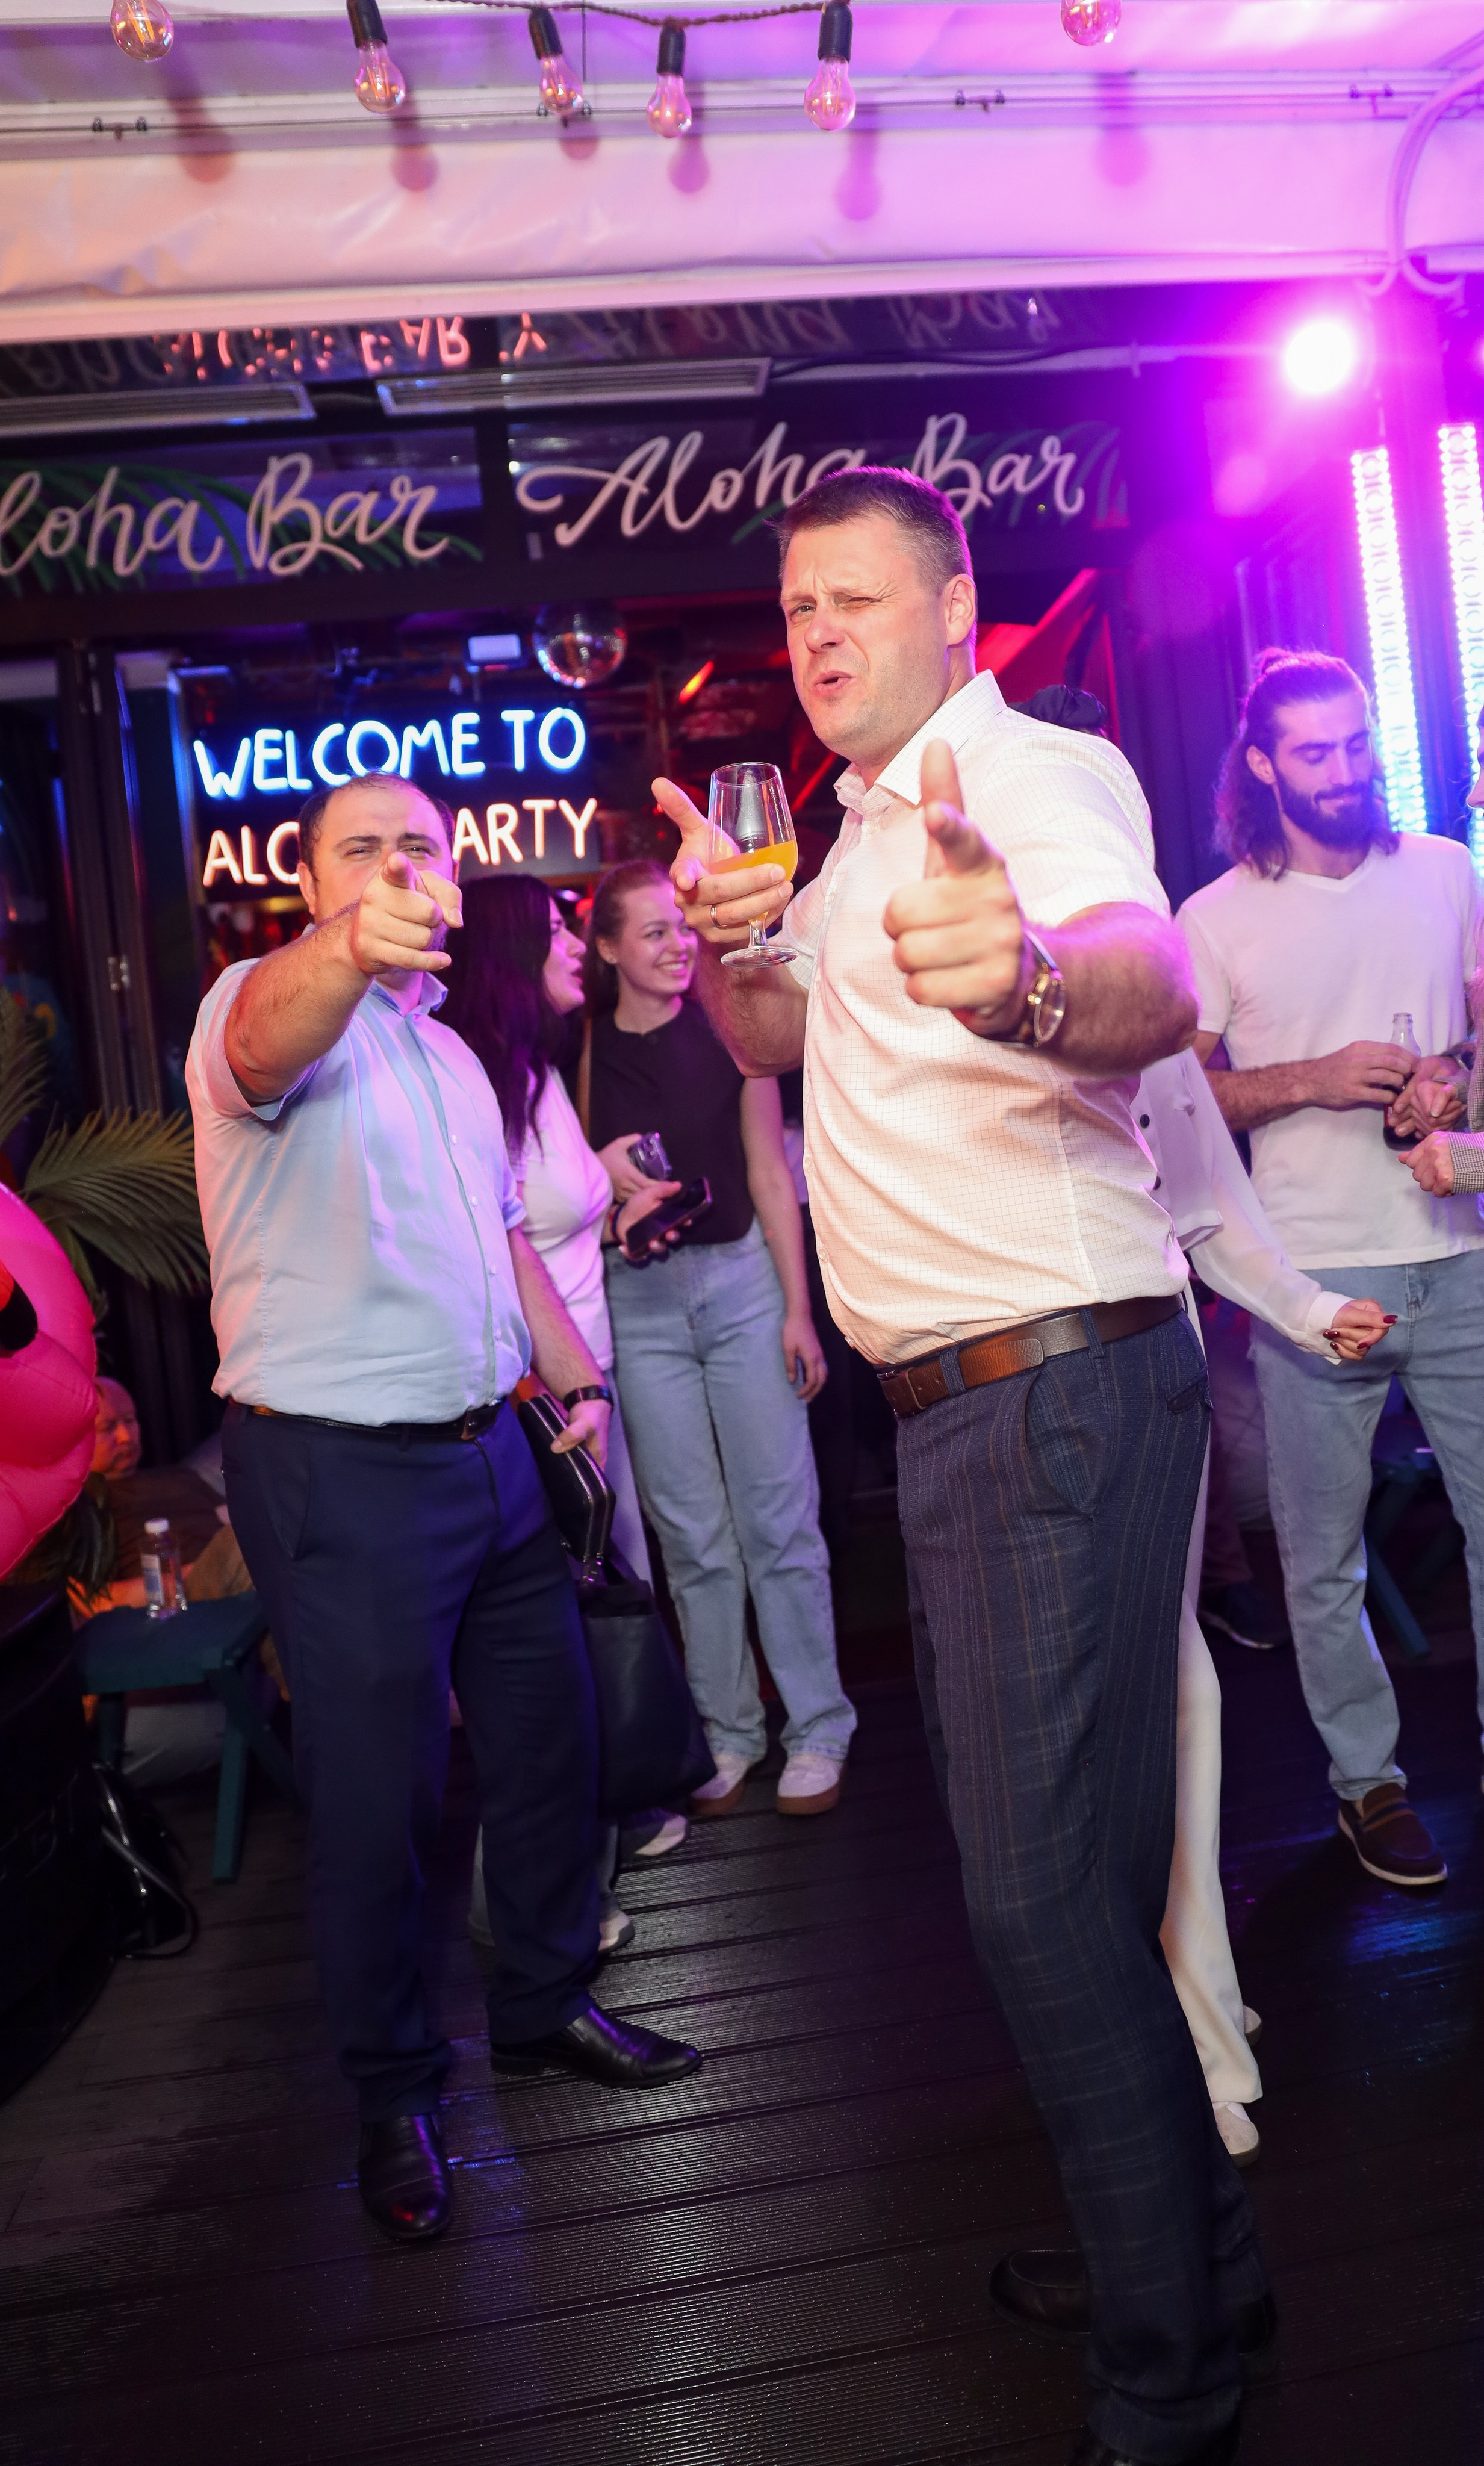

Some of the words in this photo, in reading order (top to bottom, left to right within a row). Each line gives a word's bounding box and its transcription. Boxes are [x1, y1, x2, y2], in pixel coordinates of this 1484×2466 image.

[910, 412, 1085, 517] Bar
[0, 466, 223, 577] loha
[246, 452, 450, 576] Bar
[193, 712, 486, 798] WELCOME
[500, 707, 586, 772] TO
[452, 797, 598, 866] ARTY
